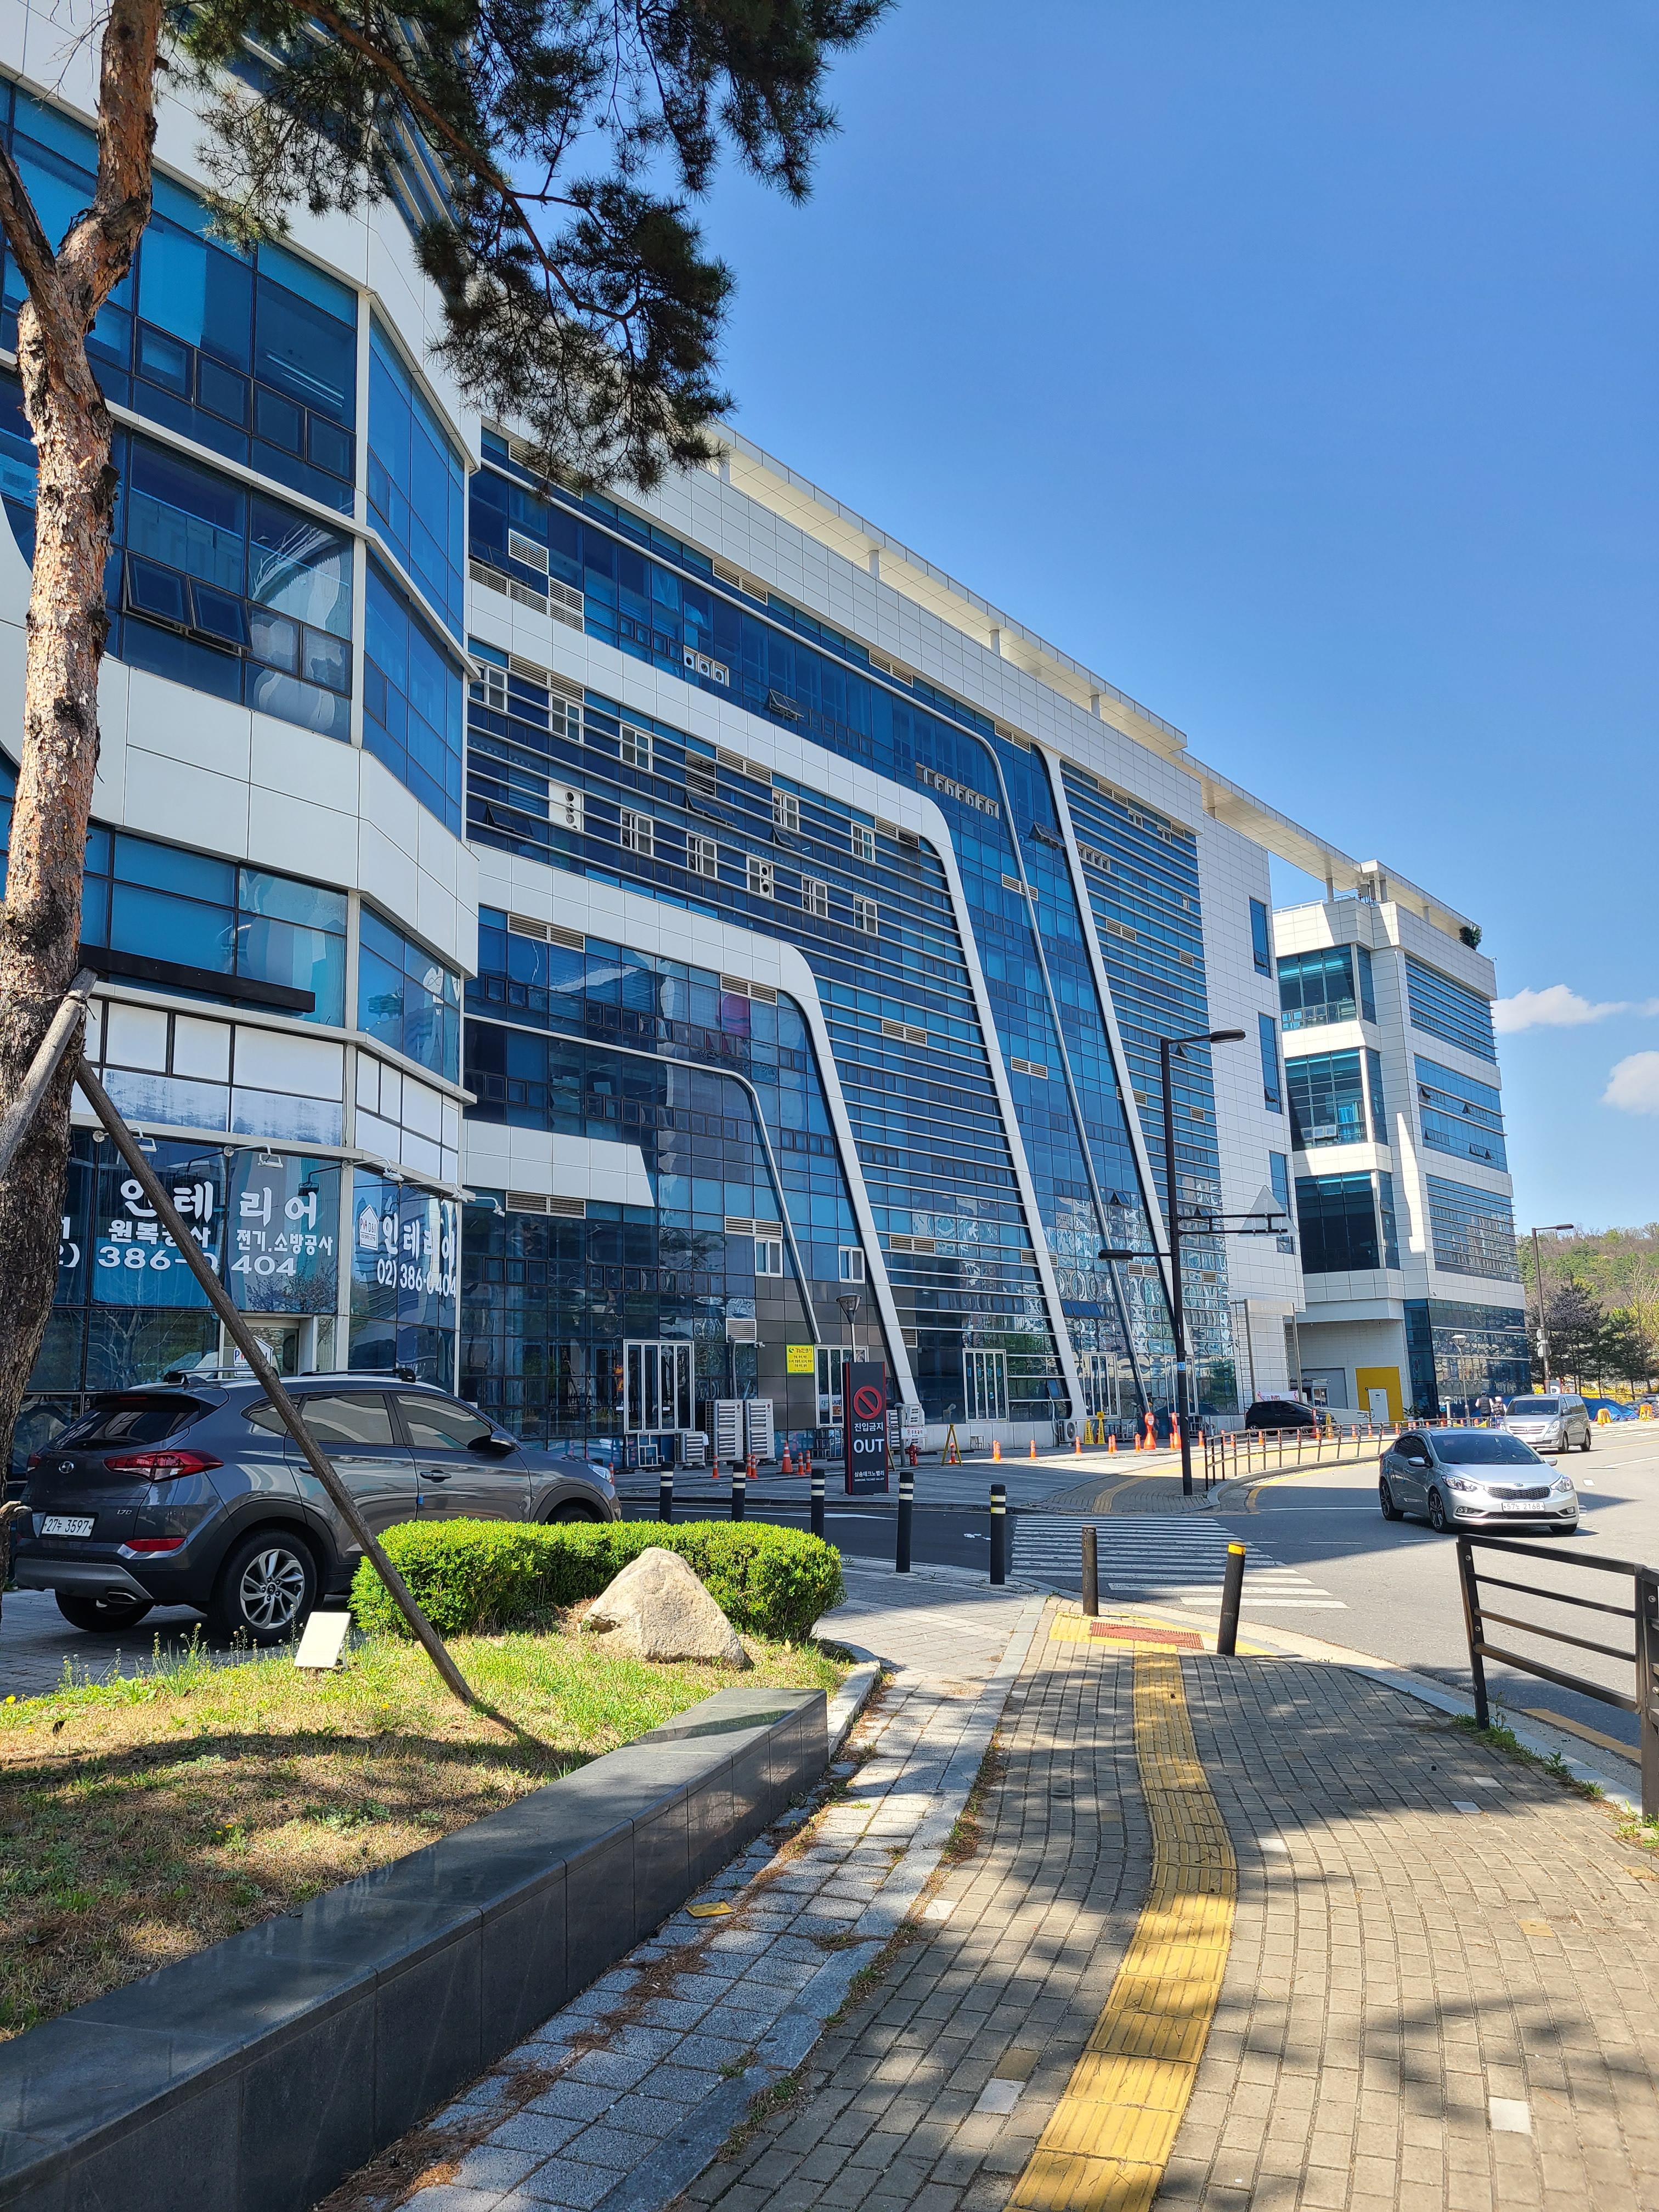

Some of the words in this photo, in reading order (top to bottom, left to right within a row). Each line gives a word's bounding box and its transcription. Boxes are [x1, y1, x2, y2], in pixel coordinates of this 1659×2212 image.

[236, 1229, 333, 1256] 전기.소방공사
[382, 1212, 455, 1269] 인테리어
[377, 1258, 397, 1289] 02)
[399, 1263, 457, 1299] 386-0404
[854, 1422, 884, 1432] 진입금지
[853, 1438, 885, 1453] OUT
[46, 1518, 62, 1532] 27누
[65, 1519, 89, 1533] 3597
